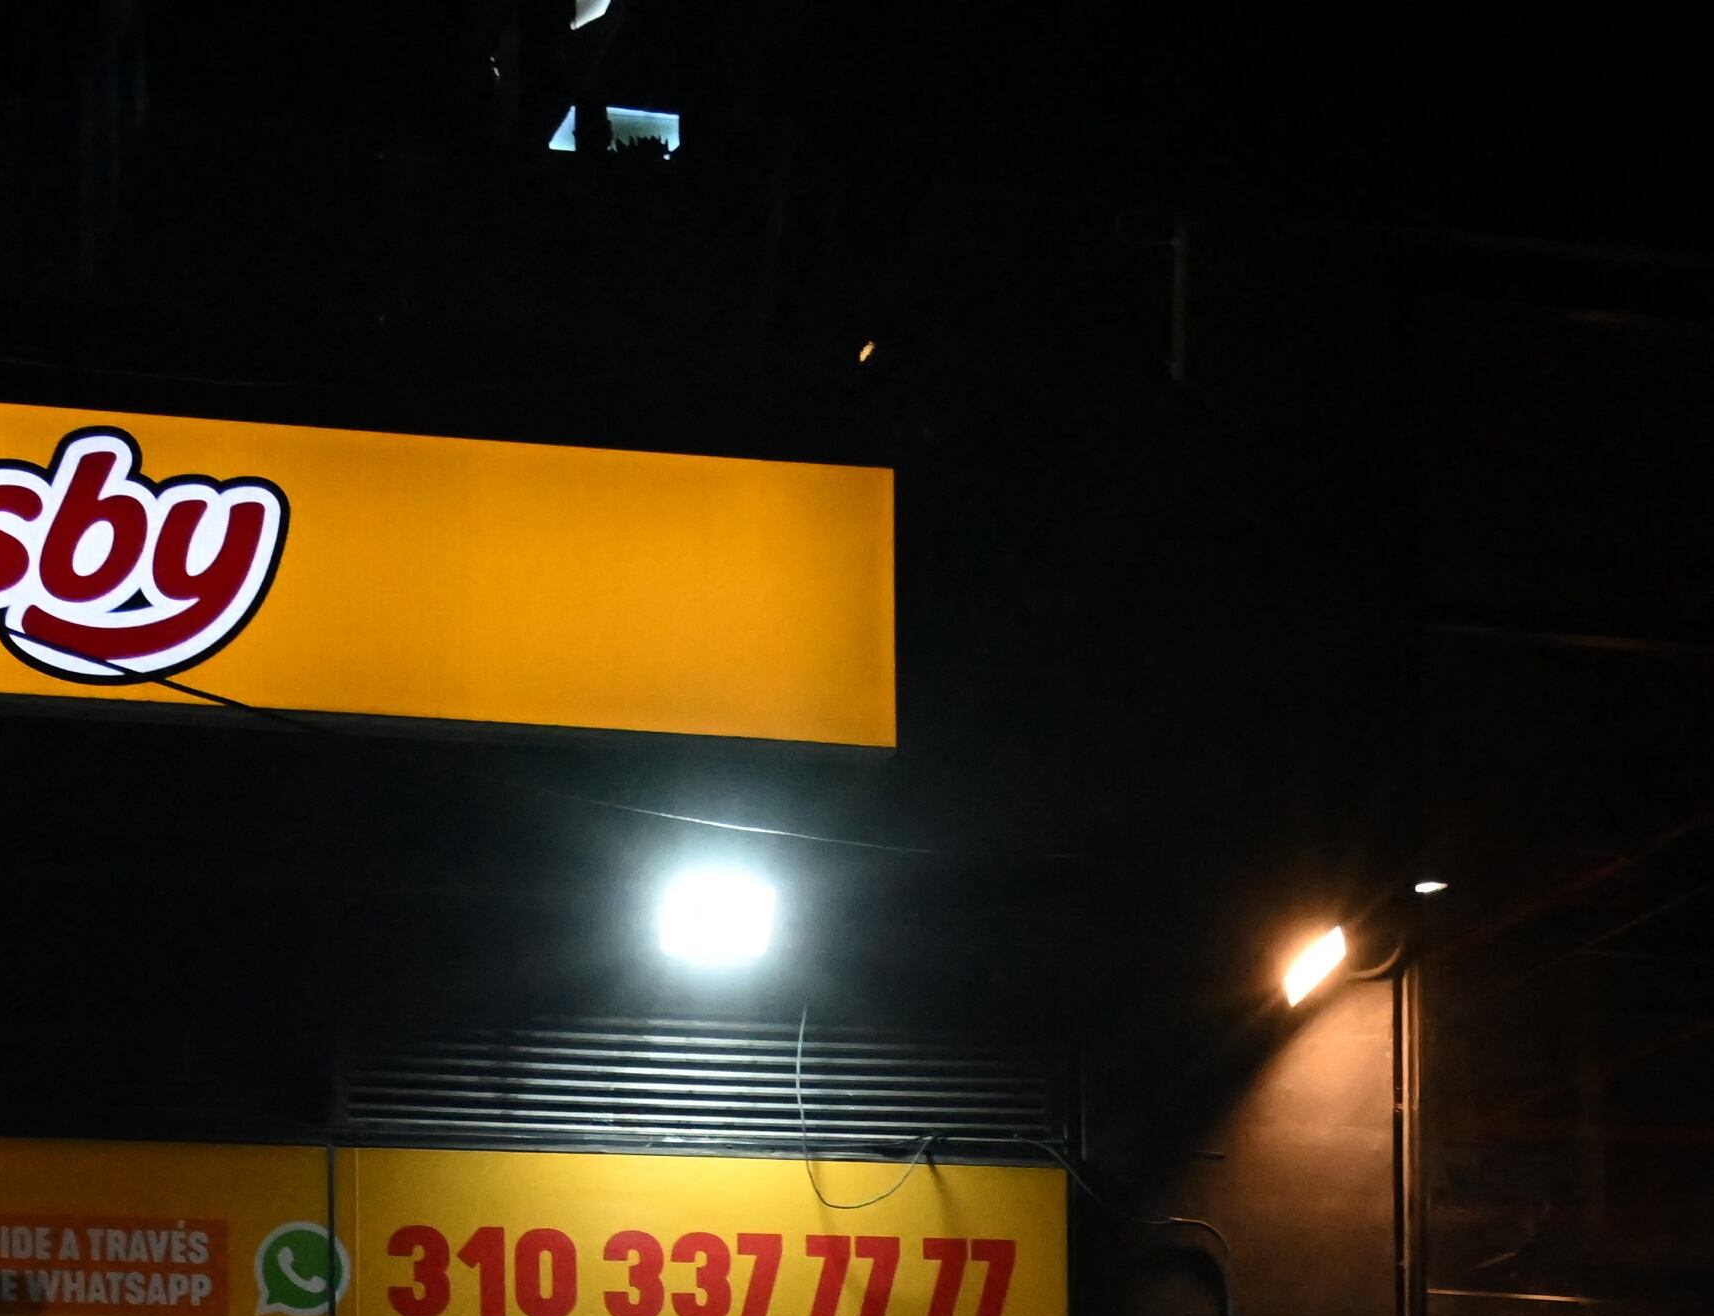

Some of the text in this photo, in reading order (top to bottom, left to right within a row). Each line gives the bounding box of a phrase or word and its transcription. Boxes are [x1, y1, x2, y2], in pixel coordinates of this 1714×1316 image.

[59, 1226, 81, 1262] A
[87, 1219, 210, 1265] TRAVÉS
[23, 1269, 213, 1307] WHATSAPP
